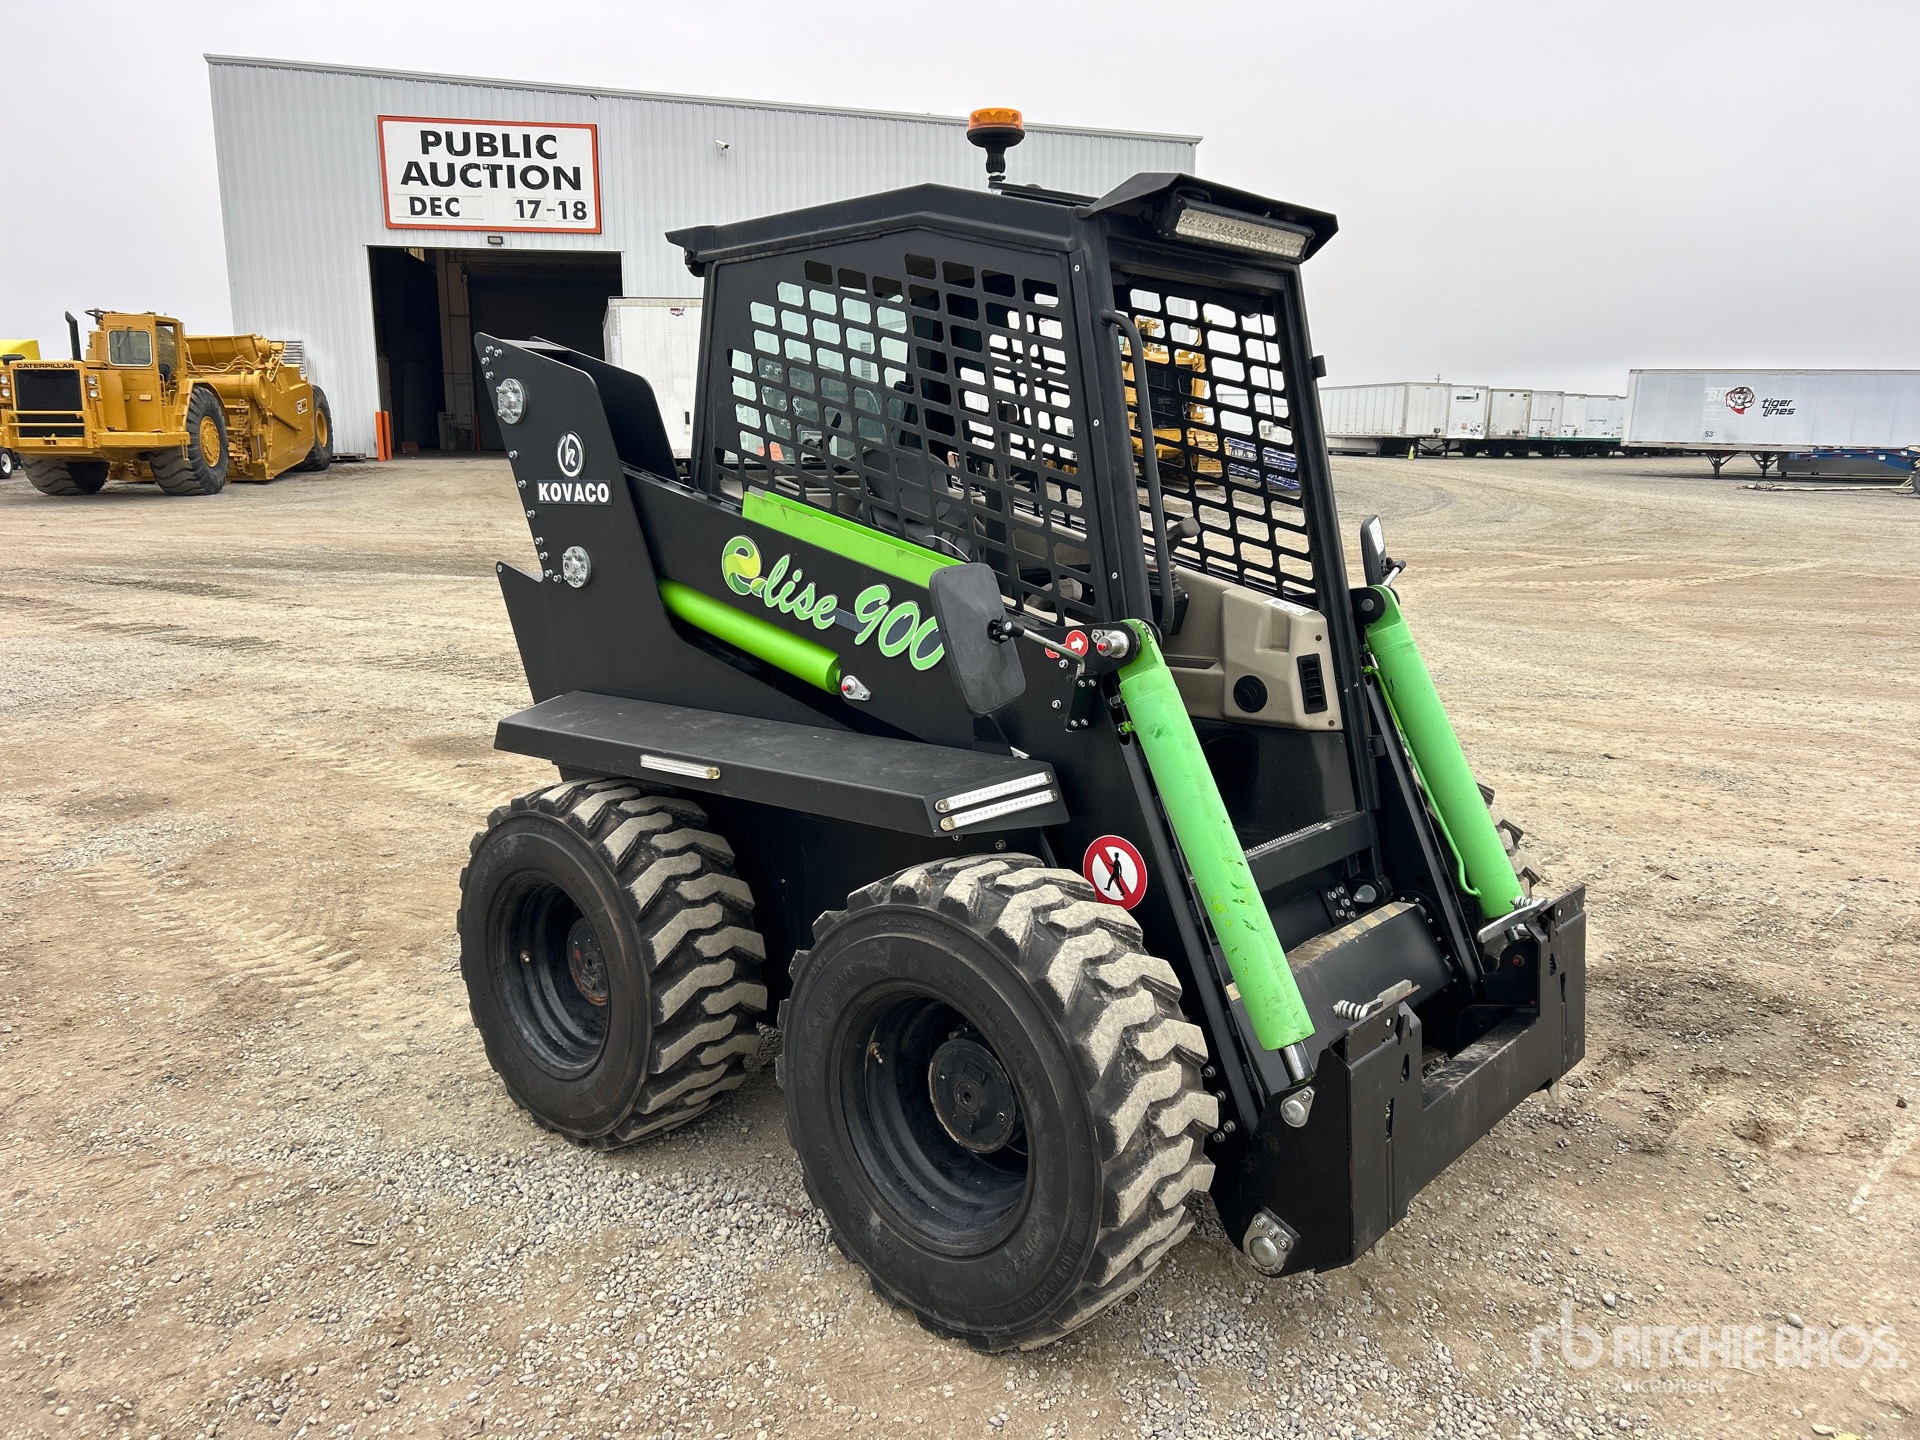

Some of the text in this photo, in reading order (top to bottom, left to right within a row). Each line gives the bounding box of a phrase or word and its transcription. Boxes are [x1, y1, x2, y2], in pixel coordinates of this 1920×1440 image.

[420, 130, 558, 160] PUBLIC
[400, 161, 582, 191] AUCTION
[409, 197, 461, 217] DEC
[17, 363, 75, 372] CATERPILLAR
[1762, 398, 1793, 408] tiger
[1762, 406, 1796, 417] lines
[538, 482, 610, 503] KOVACO
[854, 583, 945, 671] 900
